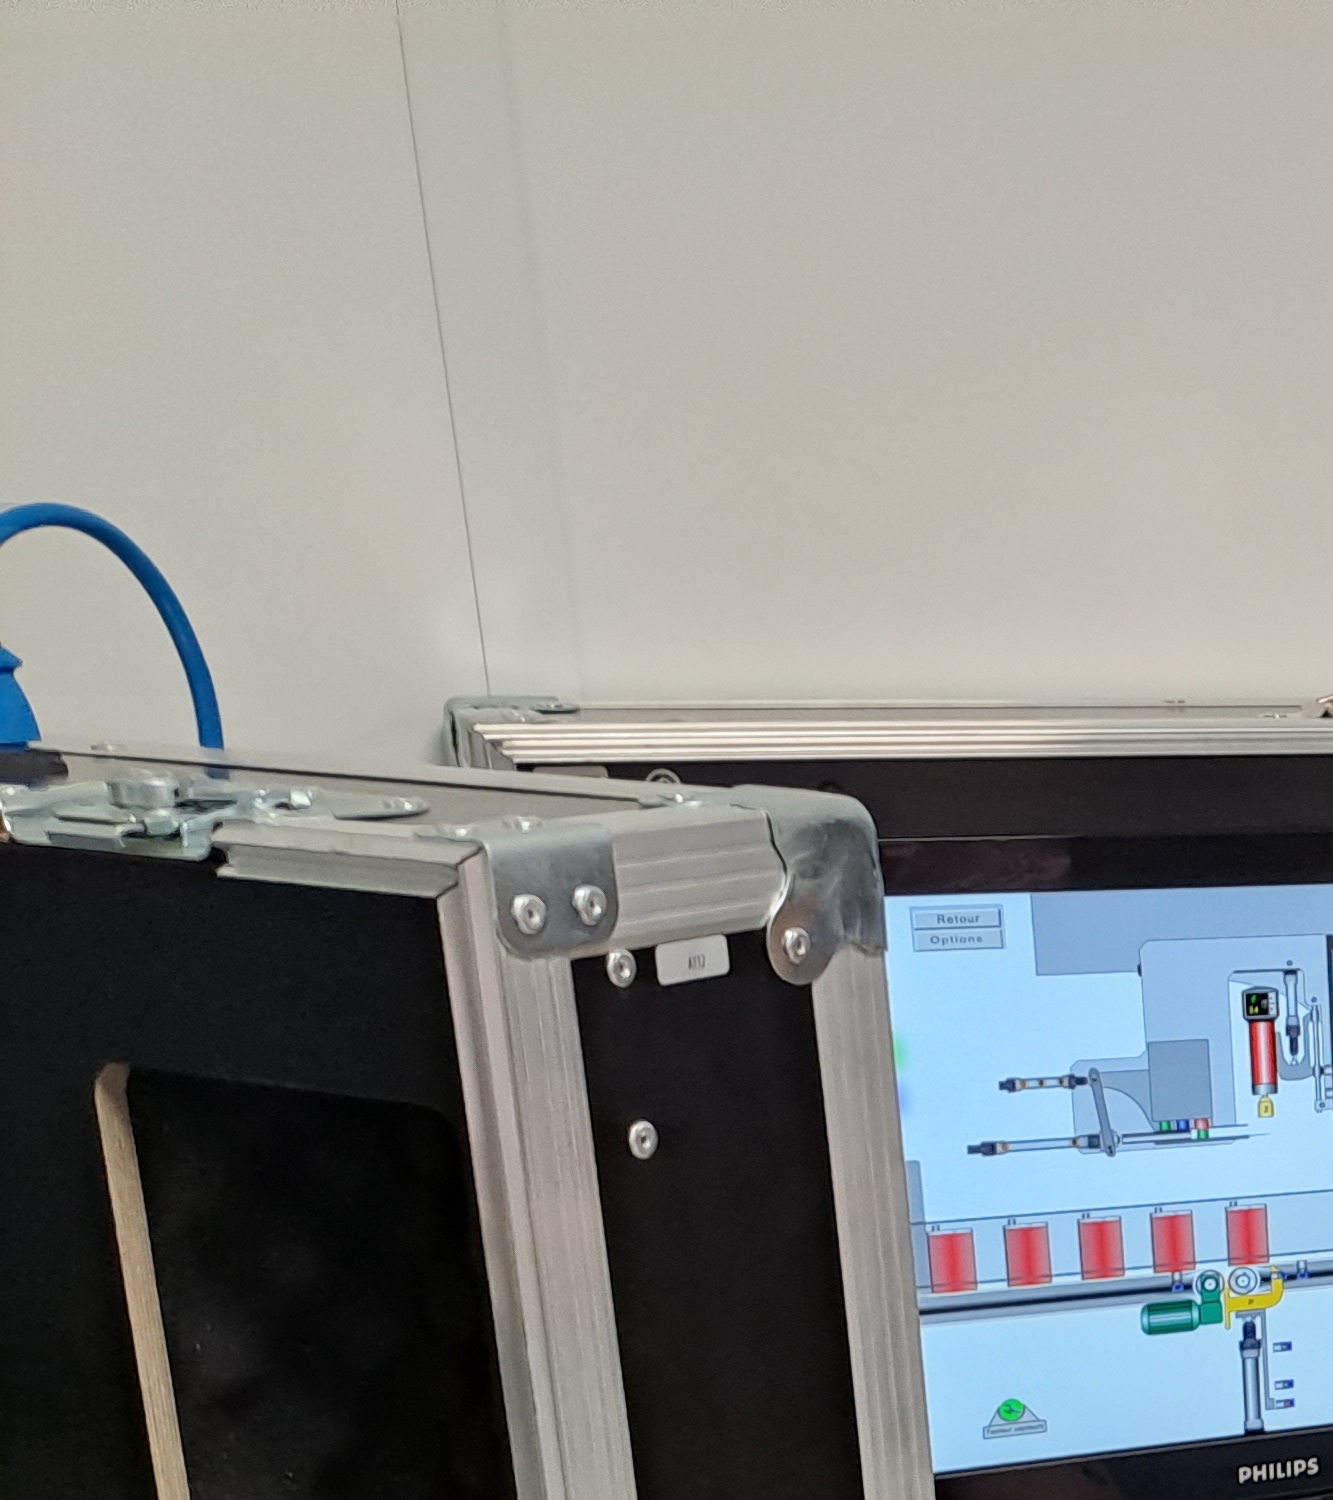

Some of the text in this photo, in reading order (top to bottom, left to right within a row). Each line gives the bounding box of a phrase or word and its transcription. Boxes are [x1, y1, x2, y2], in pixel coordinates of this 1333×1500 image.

[936, 914, 980, 925] Retour
[930, 935, 983, 946] Options
[1238, 1457, 1319, 1484] PHILIPS
